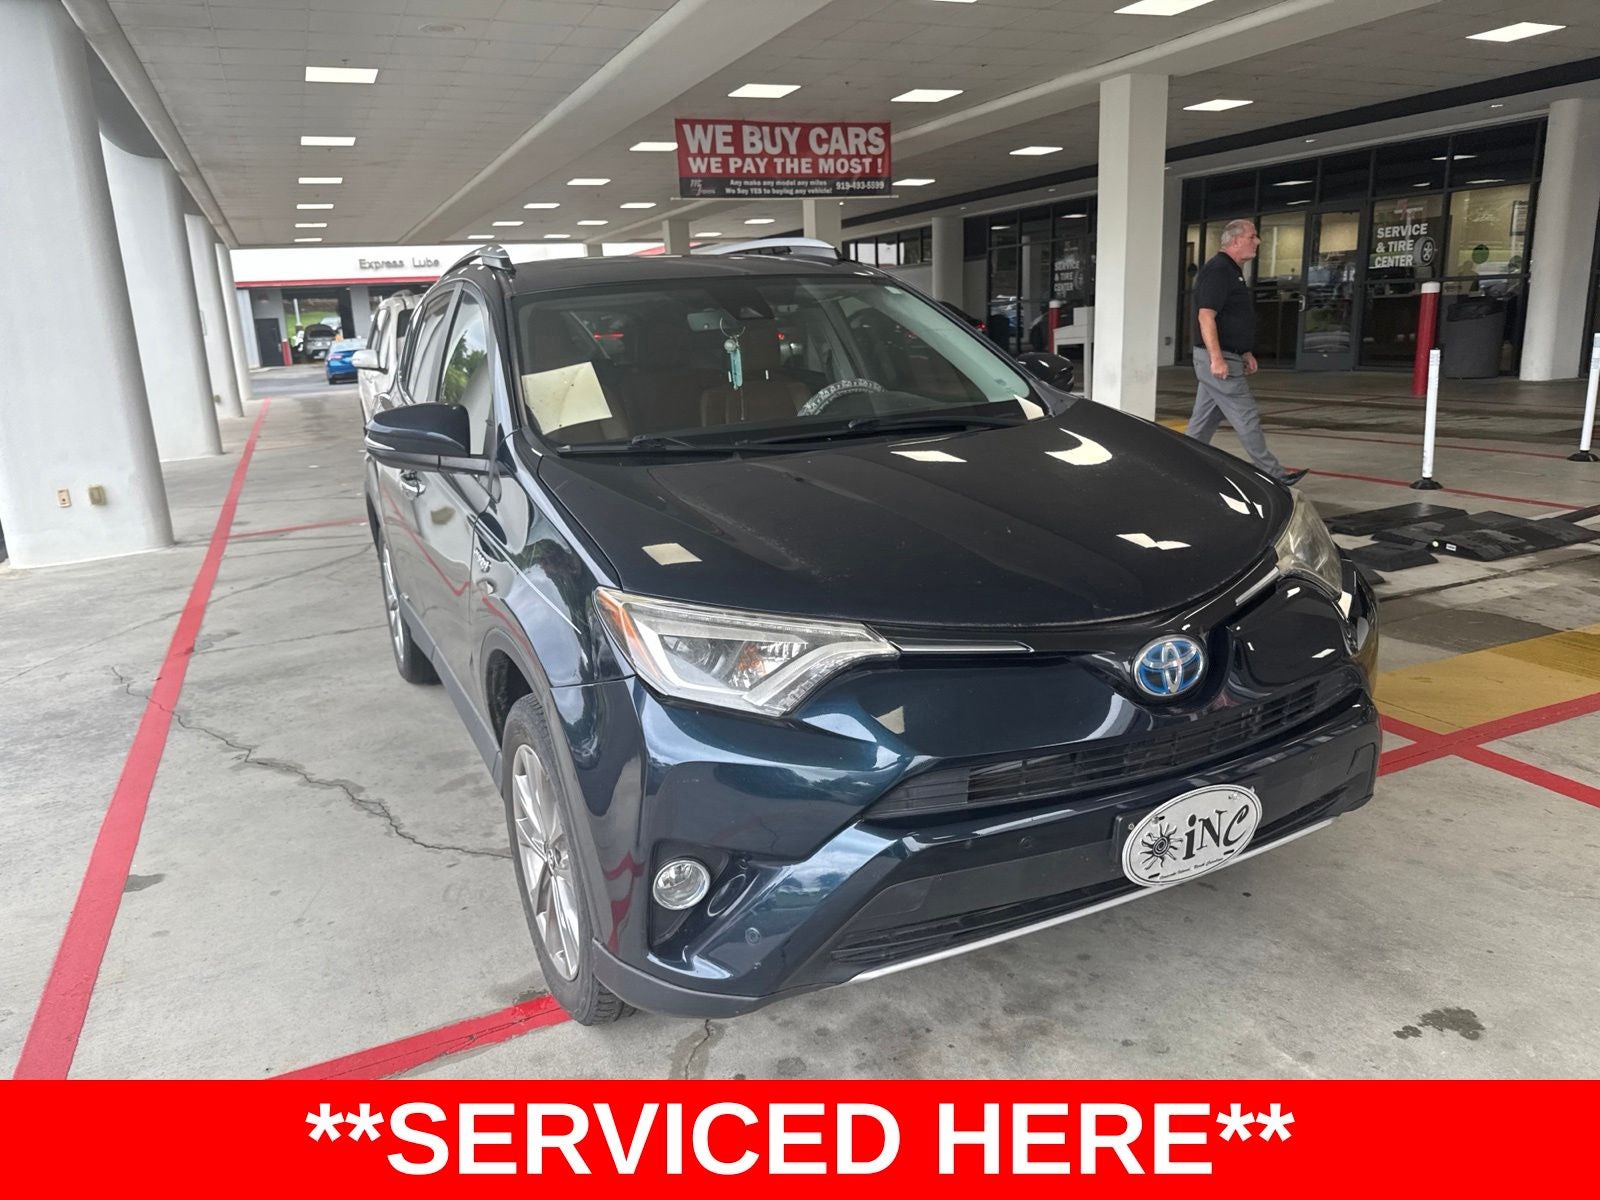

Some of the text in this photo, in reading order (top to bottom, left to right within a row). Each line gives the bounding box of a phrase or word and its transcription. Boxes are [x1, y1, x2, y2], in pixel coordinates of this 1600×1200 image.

[682, 124, 886, 156] WE BUY CARS
[688, 157, 722, 174] WE
[729, 157, 768, 174] PAY
[773, 158, 812, 174] THE
[818, 158, 872, 174] MOST
[730, 179, 742, 187] Any
[772, 187, 794, 196] buying
[1377, 223, 1429, 239] SERVICE
[1376, 240, 1415, 253] & TIRE
[359, 257, 440, 270] Express Lube
[1375, 254, 1414, 268] CENTER
